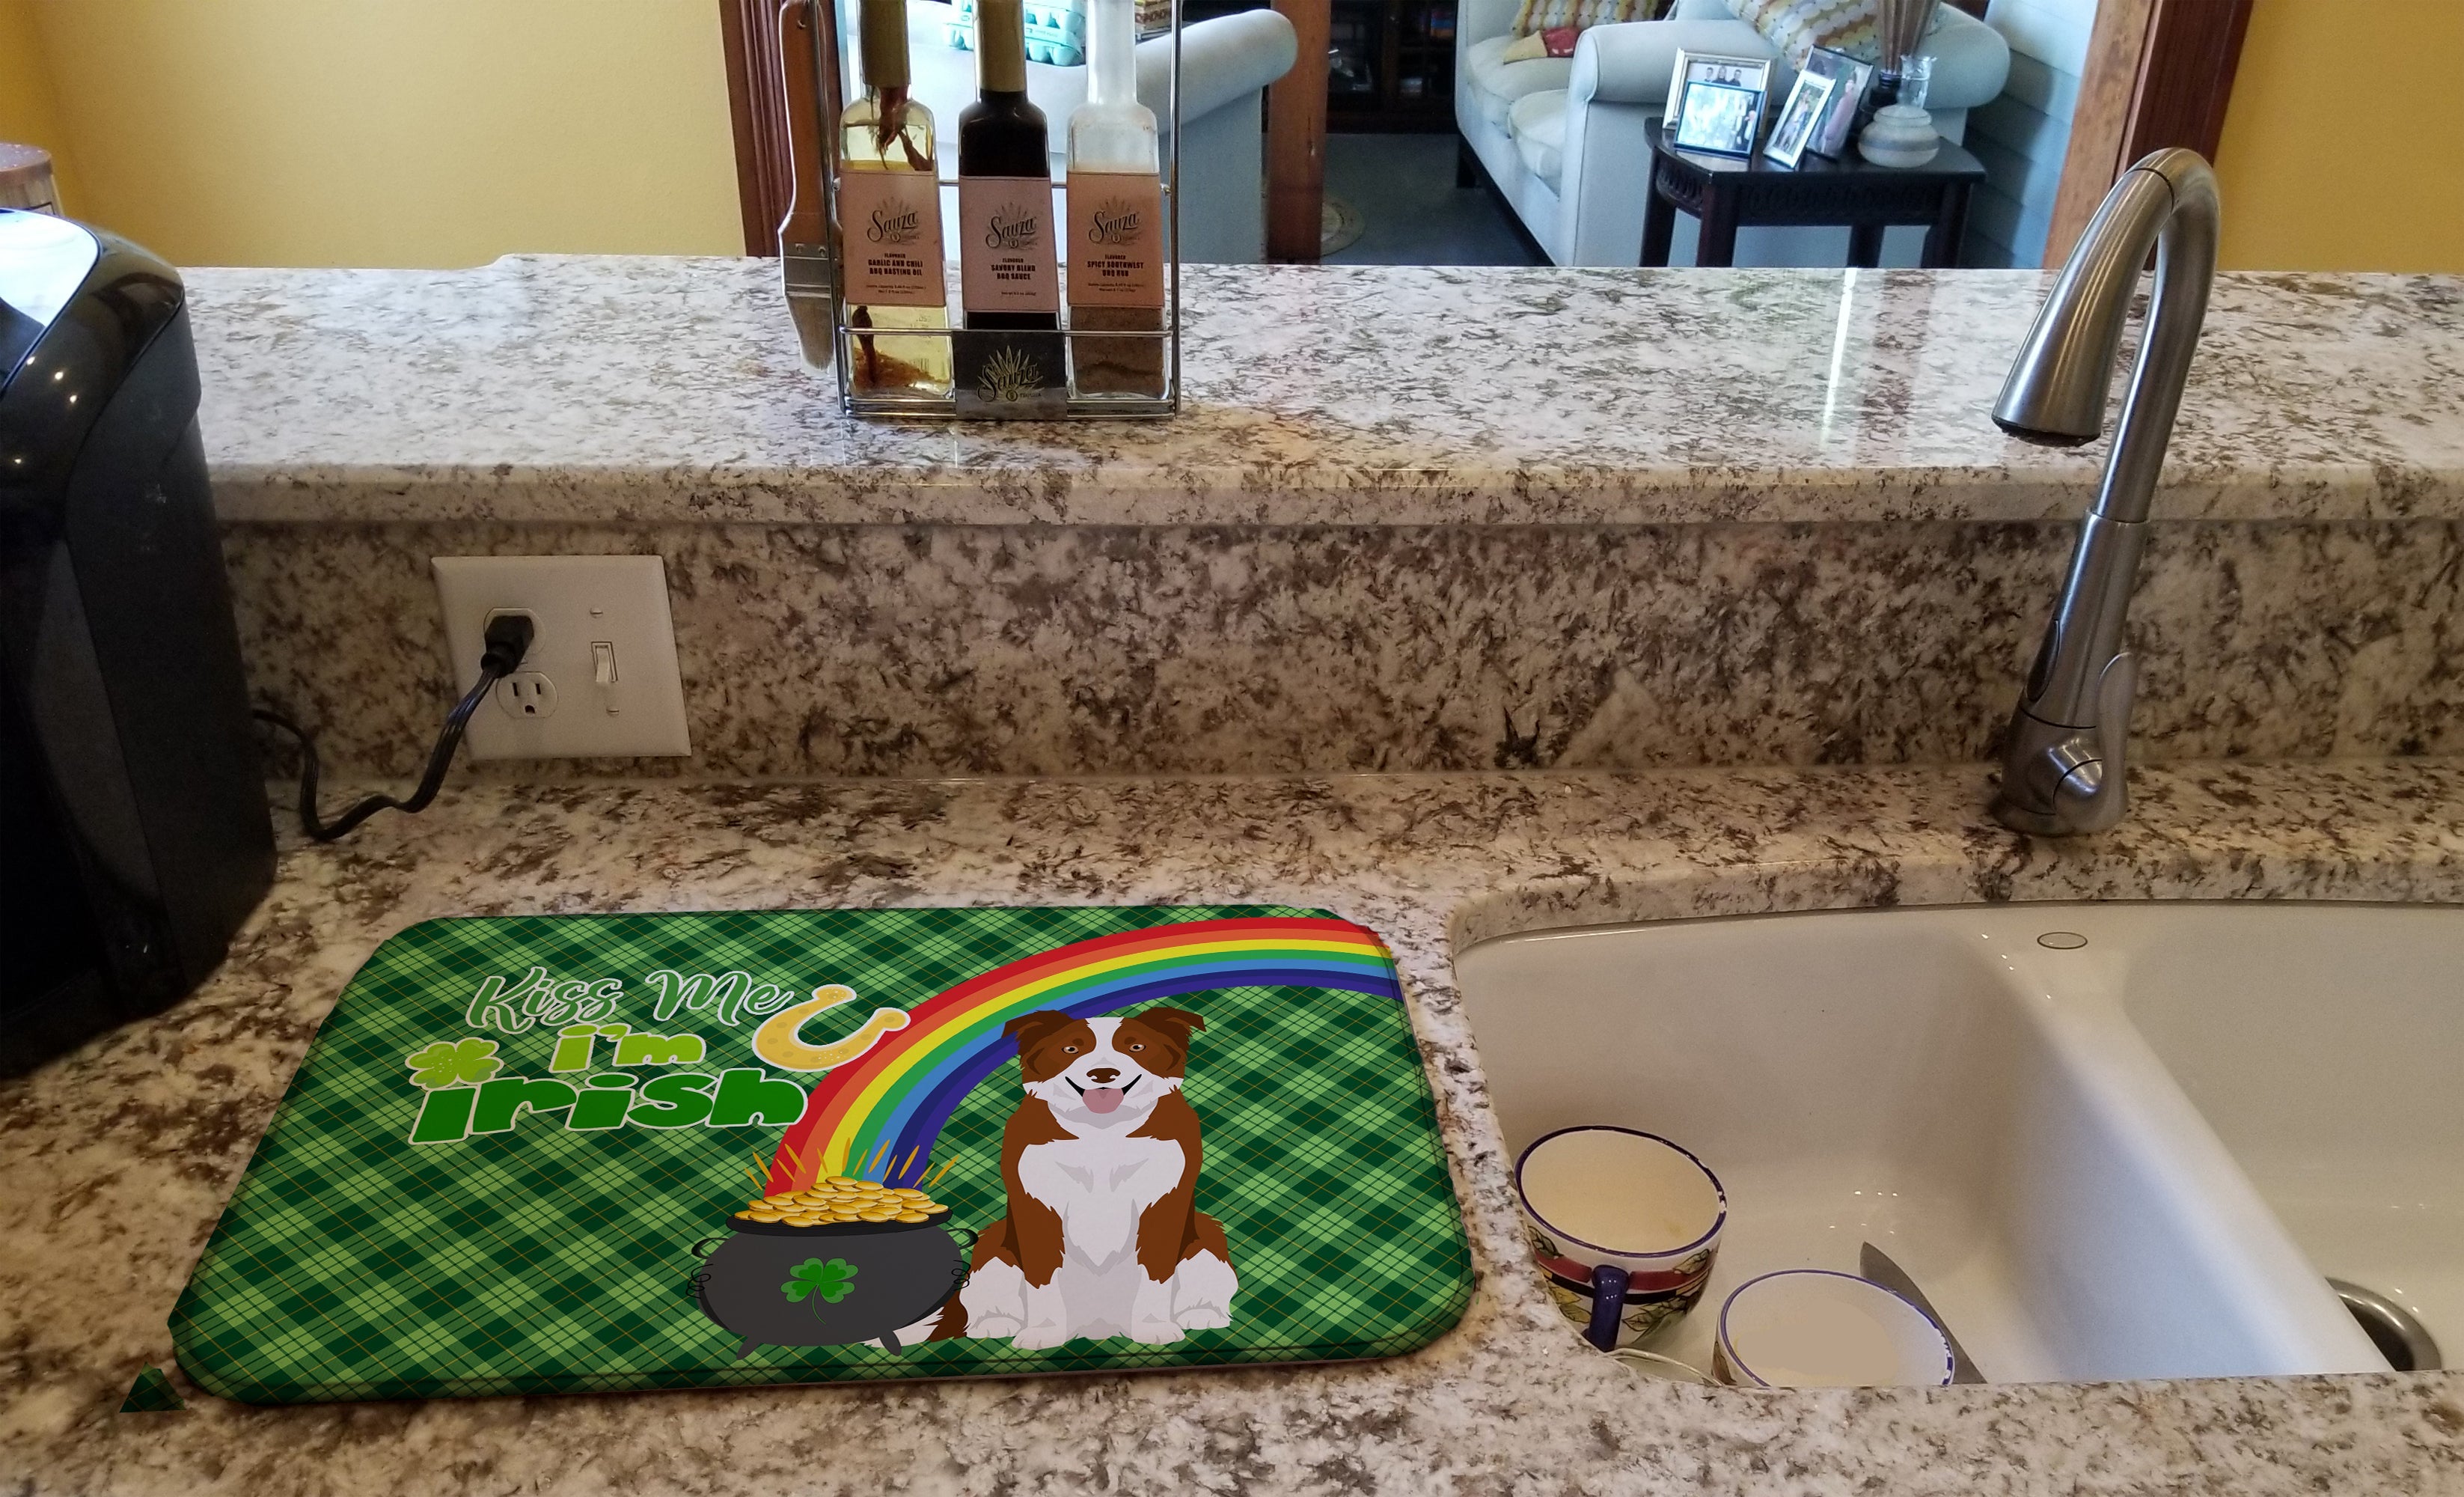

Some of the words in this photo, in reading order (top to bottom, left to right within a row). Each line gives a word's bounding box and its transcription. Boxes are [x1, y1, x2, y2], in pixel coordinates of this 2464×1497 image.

[867, 210, 918, 243] Sauza
[985, 216, 1036, 249] Sauza
[1089, 210, 1140, 244] Sauza
[869, 267, 883, 275] BBQ
[977, 363, 1039, 403] Sauza
[465, 966, 623, 1034] Kiss
[645, 969, 795, 1026] Me
